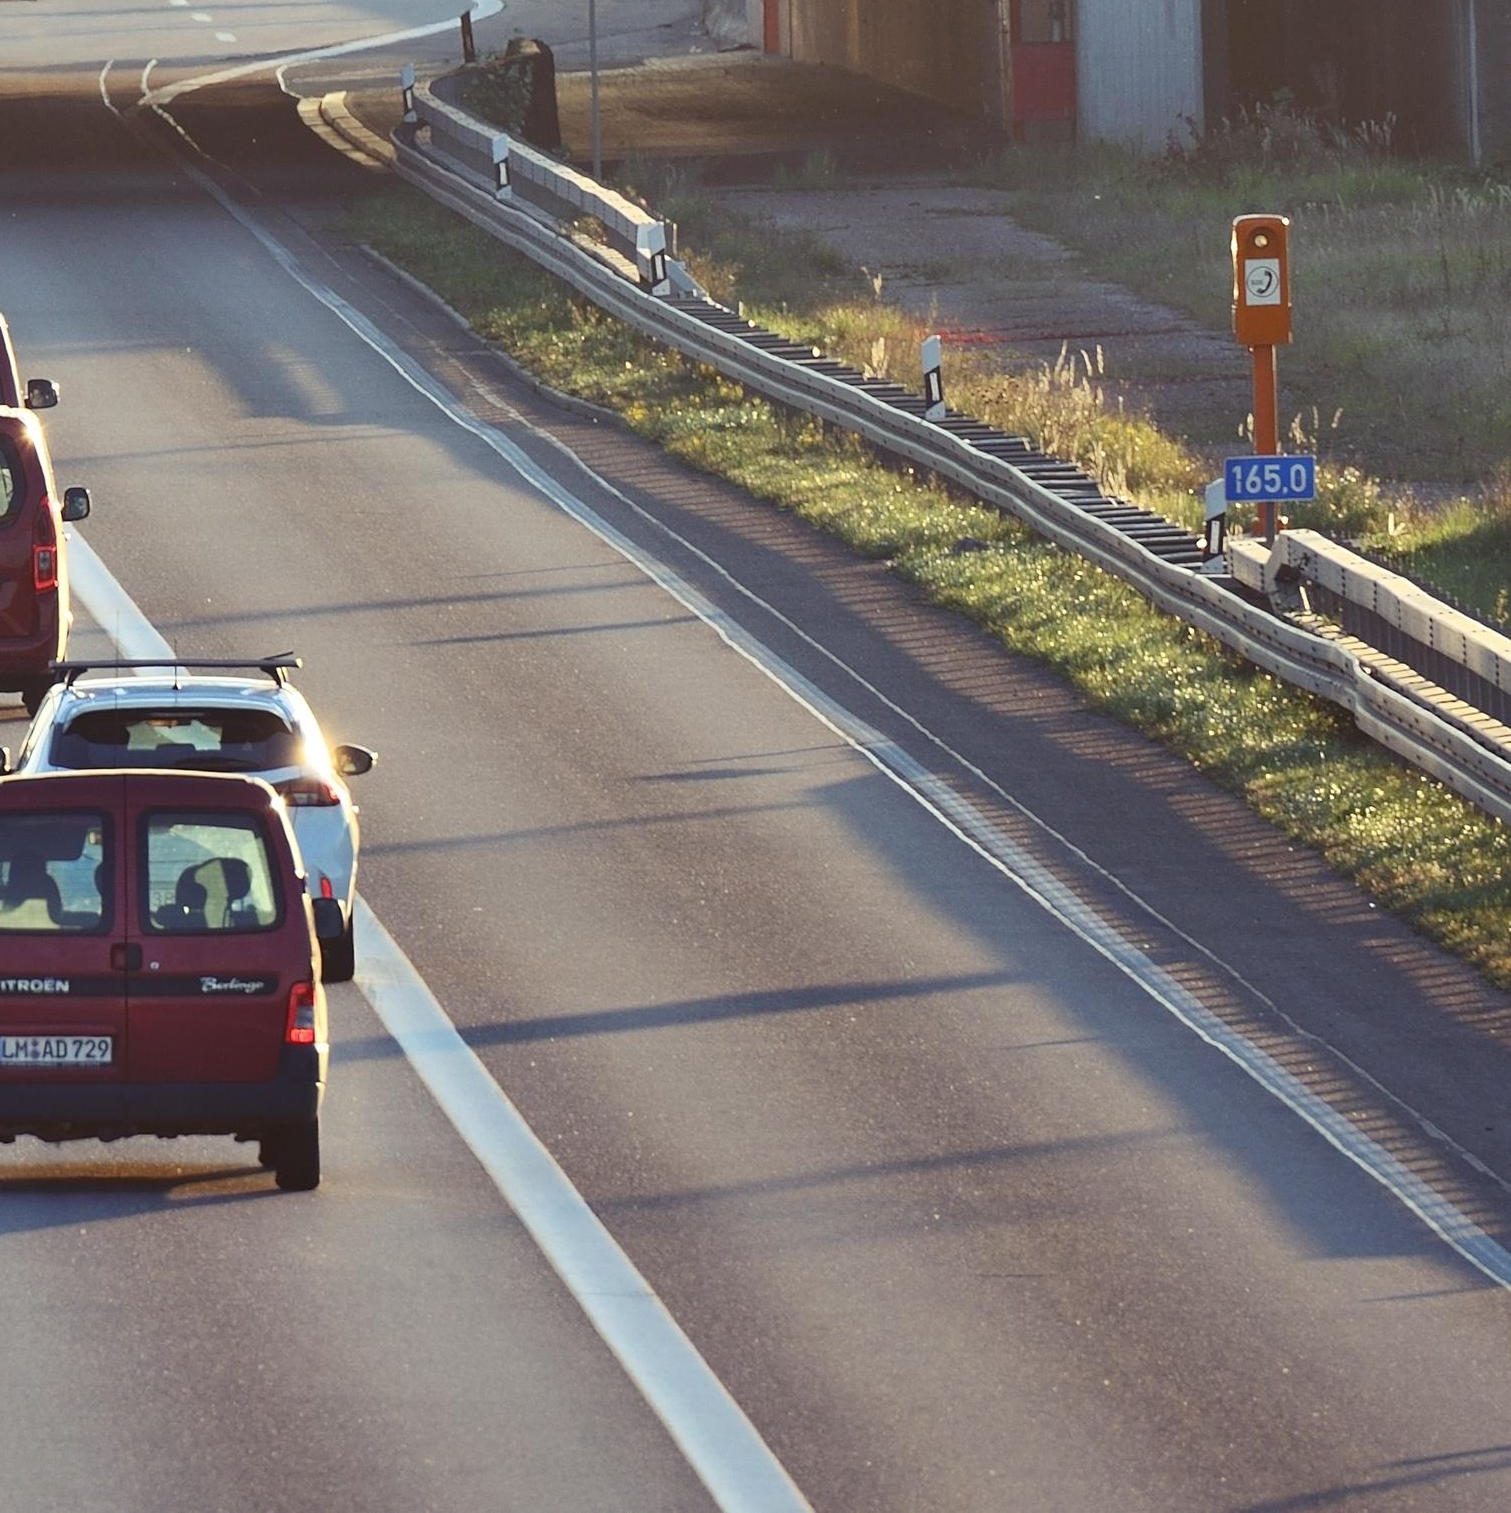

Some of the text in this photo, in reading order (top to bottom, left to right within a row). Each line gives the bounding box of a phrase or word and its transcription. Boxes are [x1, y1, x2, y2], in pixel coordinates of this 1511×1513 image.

[1231, 463, 1308, 495] 165,0
[200, 977, 265, 994] Berlingo
[2, 1039, 109, 1059] LM AD 729
